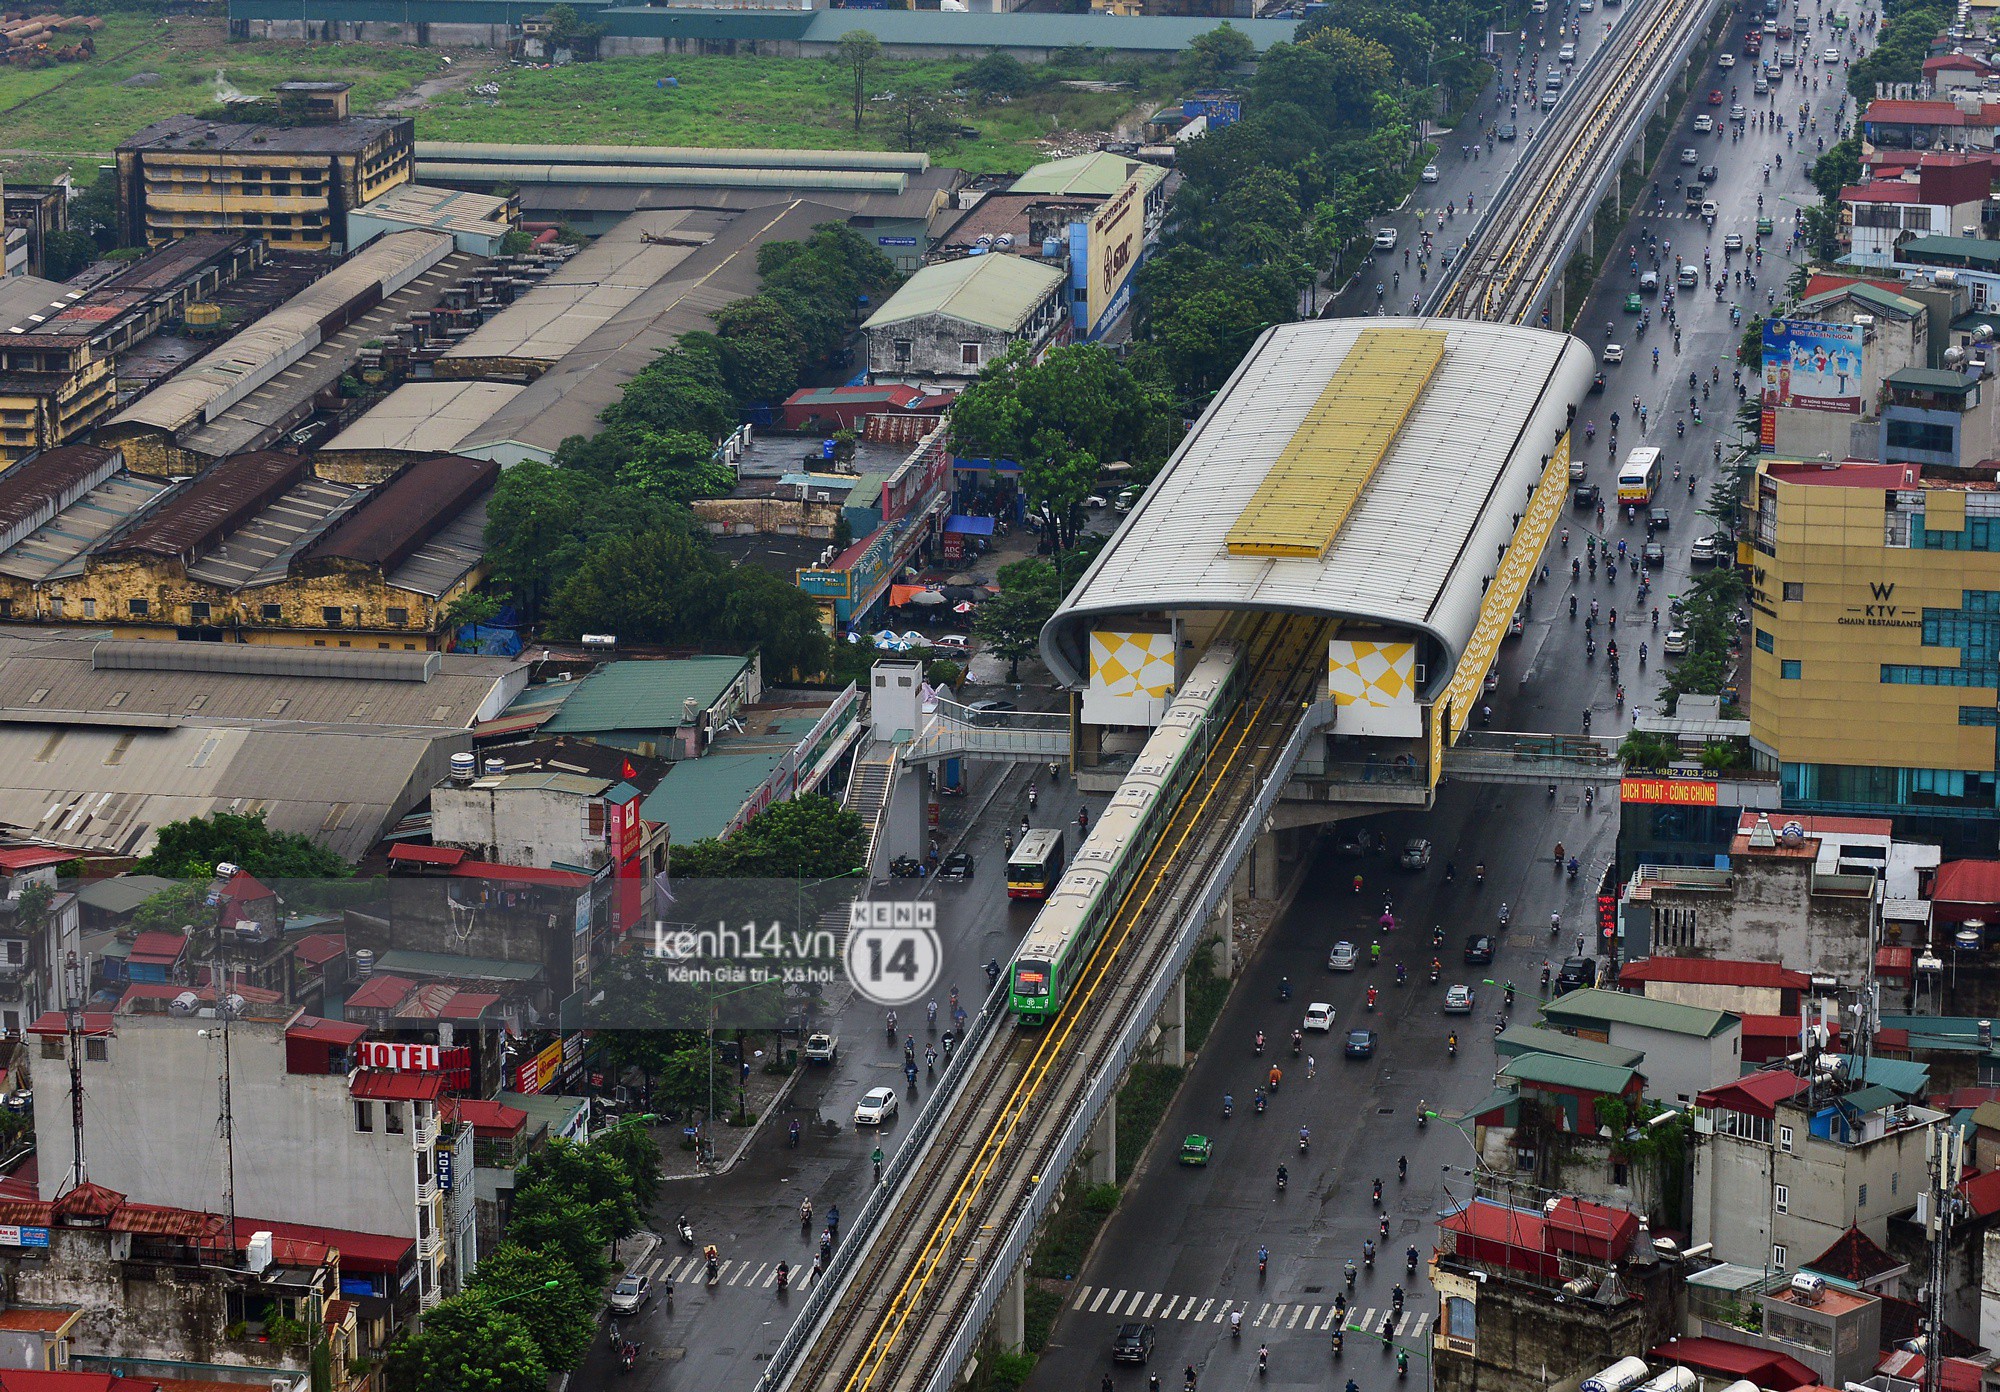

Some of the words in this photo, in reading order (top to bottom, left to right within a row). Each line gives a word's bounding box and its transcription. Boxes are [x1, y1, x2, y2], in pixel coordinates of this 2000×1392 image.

[1869, 582, 1895, 601] W
[1866, 604, 1896, 617] KTV
[1622, 782, 1639, 802] DỊCH
[1641, 781, 1664, 802] THUẬT
[1669, 782, 1689, 801] CÔNG
[357, 1042, 438, 1070] HOTEL
[438, 1152, 449, 1189] HOTEL
